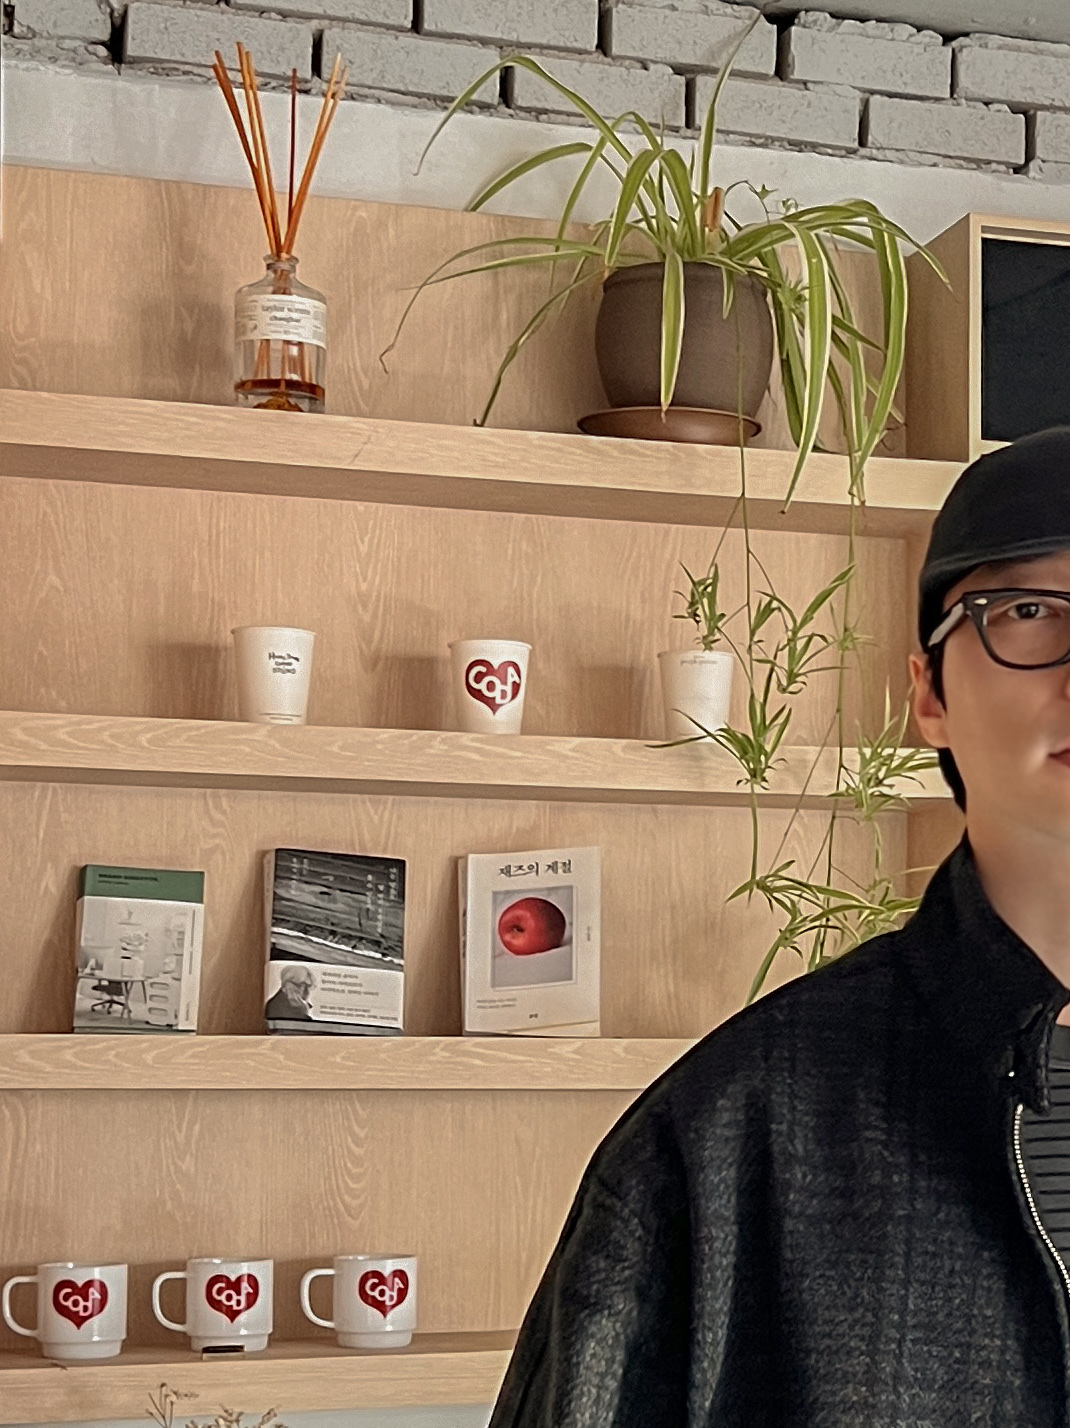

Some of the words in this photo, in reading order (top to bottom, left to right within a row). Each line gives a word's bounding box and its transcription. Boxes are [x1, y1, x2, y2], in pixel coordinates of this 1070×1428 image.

[468, 665, 521, 704] CODA
[499, 862, 539, 878] 재즈의
[58, 1288, 102, 1317] CODA
[212, 1281, 254, 1310] CODA
[364, 1277, 404, 1306] CODA
